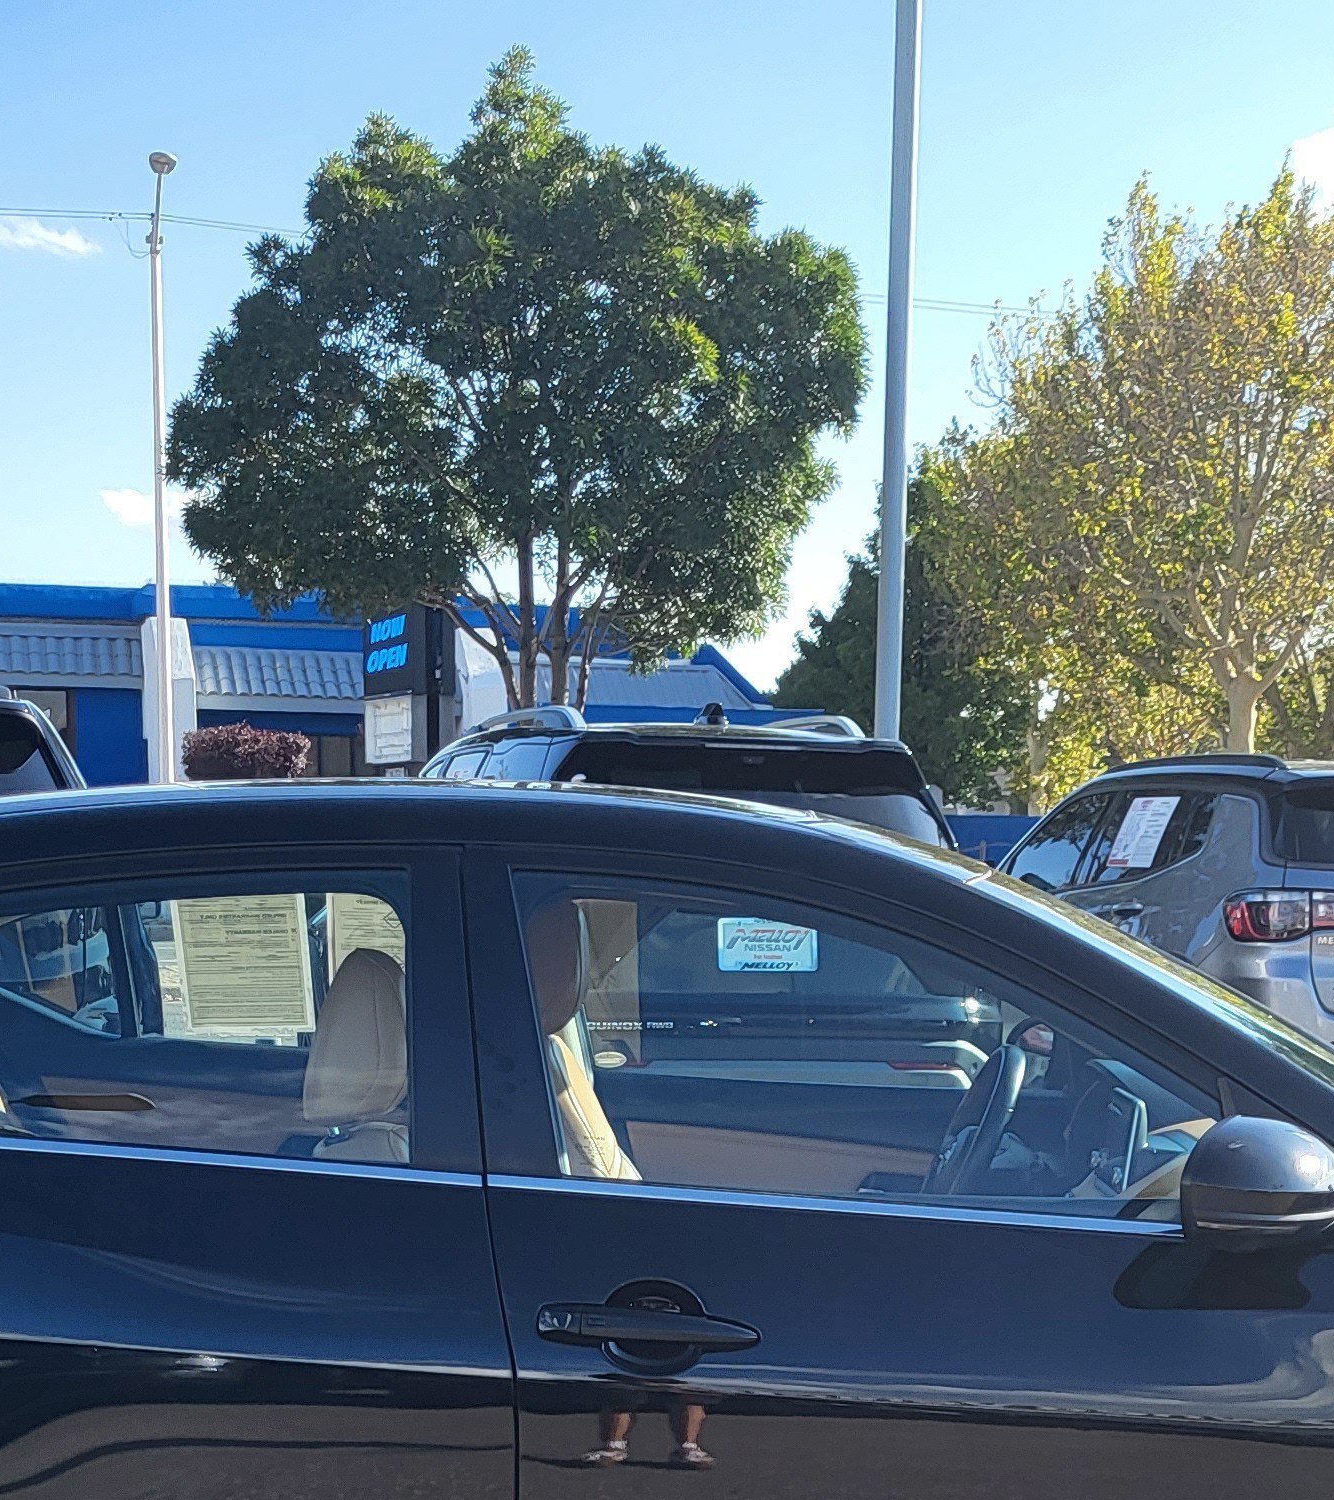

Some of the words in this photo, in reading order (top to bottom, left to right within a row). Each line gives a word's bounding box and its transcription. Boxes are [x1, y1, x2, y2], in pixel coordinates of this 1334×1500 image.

[370, 614, 406, 644] NOW
[367, 643, 408, 674] OPEN
[726, 928, 809, 950] MELLOY
[744, 944, 791, 952] NISSAN
[740, 961, 794, 970] MELLOY
